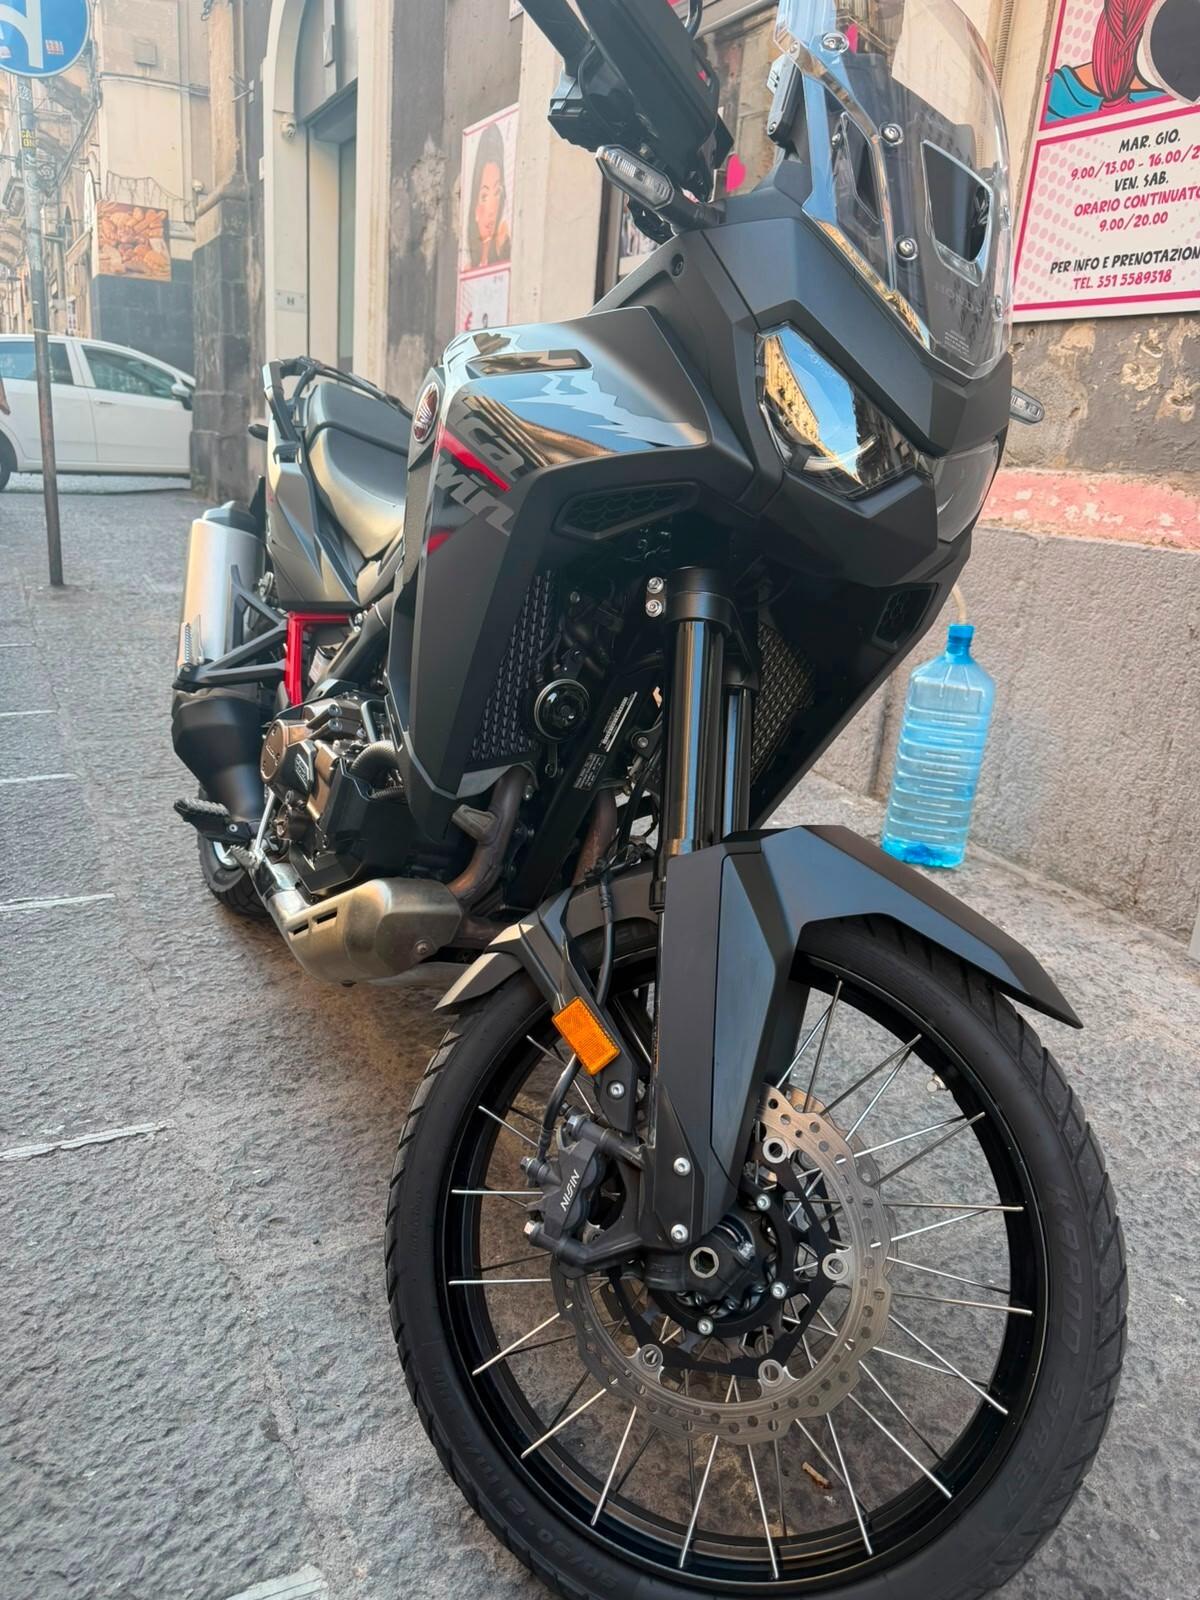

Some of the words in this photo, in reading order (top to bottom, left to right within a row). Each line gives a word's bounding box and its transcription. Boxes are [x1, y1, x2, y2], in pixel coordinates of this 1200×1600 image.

[1118, 135, 1151, 154] MAR.
[1155, 128, 1181, 145] GIO.
[1071, 158, 1135, 181] 9.00/13.00
[1114, 176, 1139, 192] VEN.
[1074, 198, 1120, 217] ORARIO
[1099, 211, 1169, 232] 9.00/20.00
[1050, 260, 1072, 274] PER
[1073, 257, 1100, 272] INFO
[1102, 256, 1110, 269] E
[1073, 277, 1094, 290] TEL.
[1097, 274, 1117, 289] 351
[1119, 269, 1172, 286] 5589318
[560, 1168, 580, 1212] NISSIN
